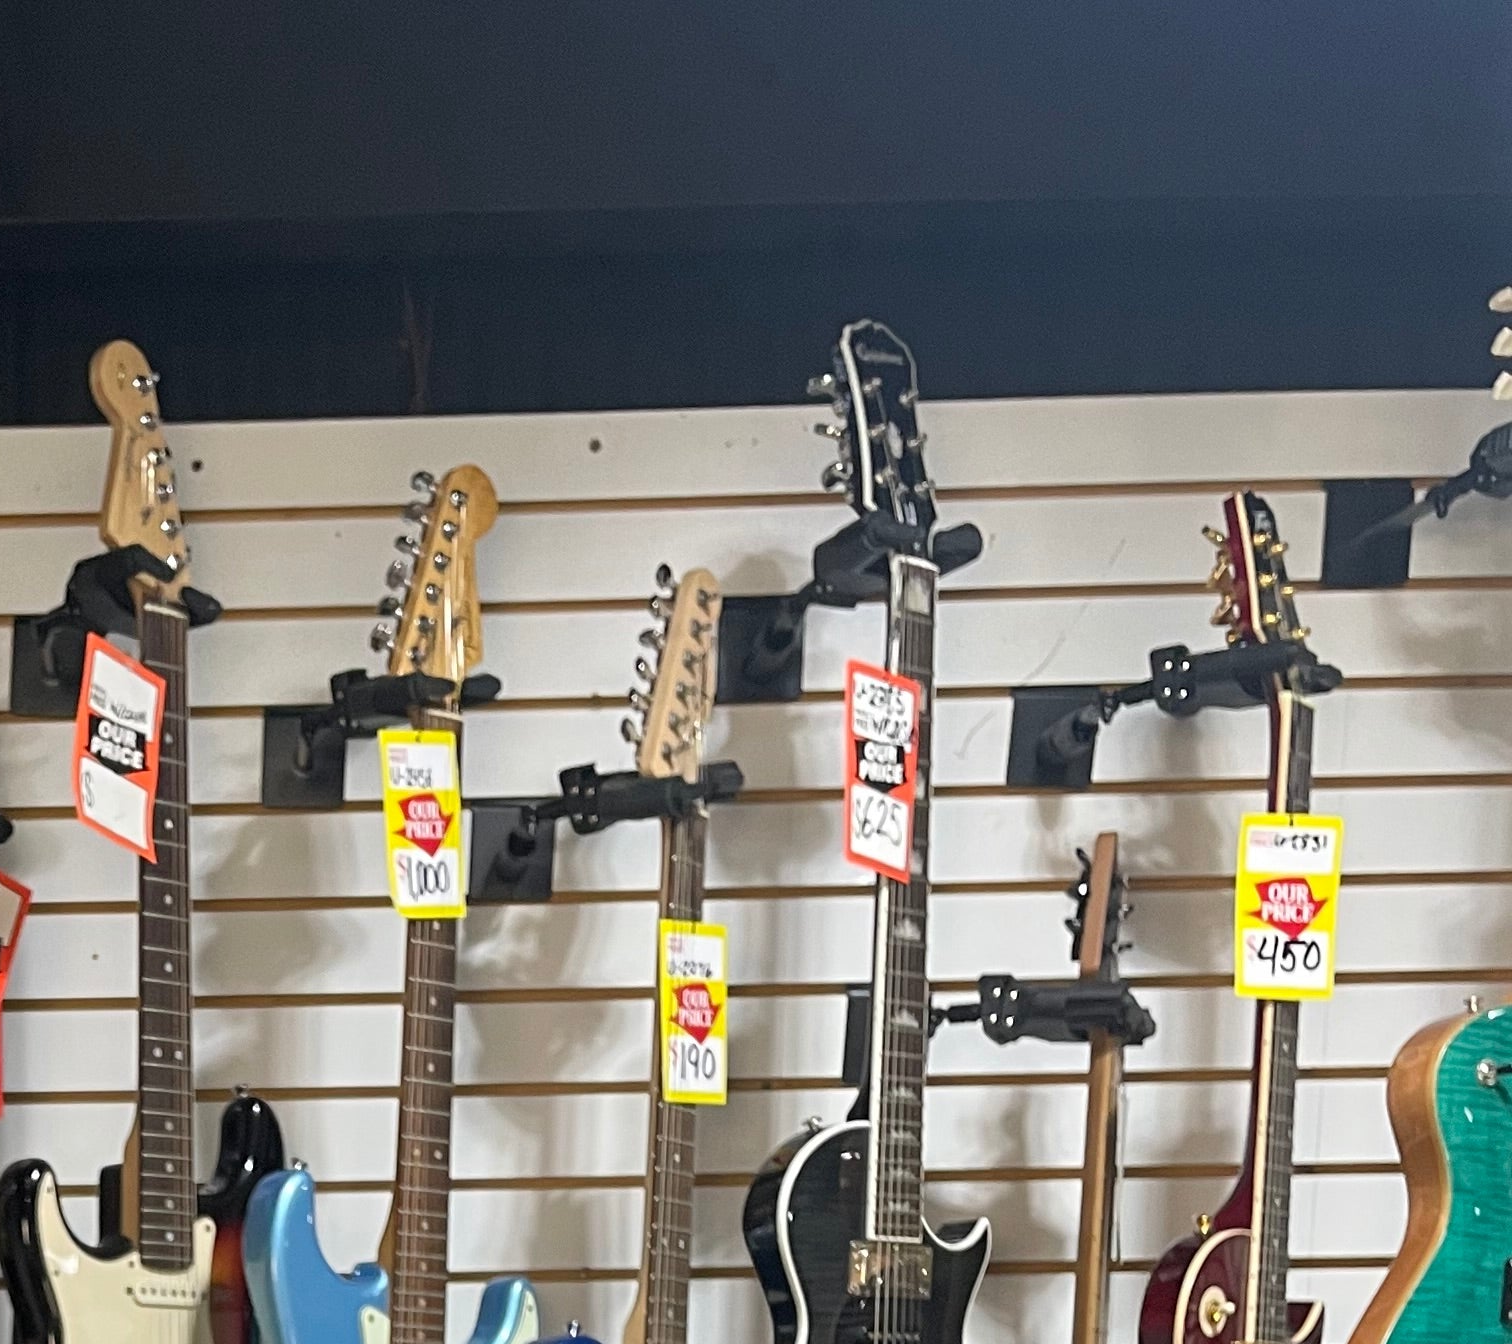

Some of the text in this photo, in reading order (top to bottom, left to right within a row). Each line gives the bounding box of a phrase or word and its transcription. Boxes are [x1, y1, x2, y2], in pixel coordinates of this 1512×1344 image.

[98, 719, 138, 748] OUR
[90, 737, 145, 769] PRICE
[863, 741, 898, 764] OUR
[858, 759, 904, 785] PRICE
[407, 800, 440, 820] OUR
[855, 797, 903, 846] $625
[405, 819, 446, 840] PRICE
[1268, 882, 1310, 902] OUR
[1261, 900, 1316, 924] PRICE
[1246, 935, 1322, 976] $450
[681, 987, 711, 1009] OUR
[670, 1039, 717, 1080] $190
